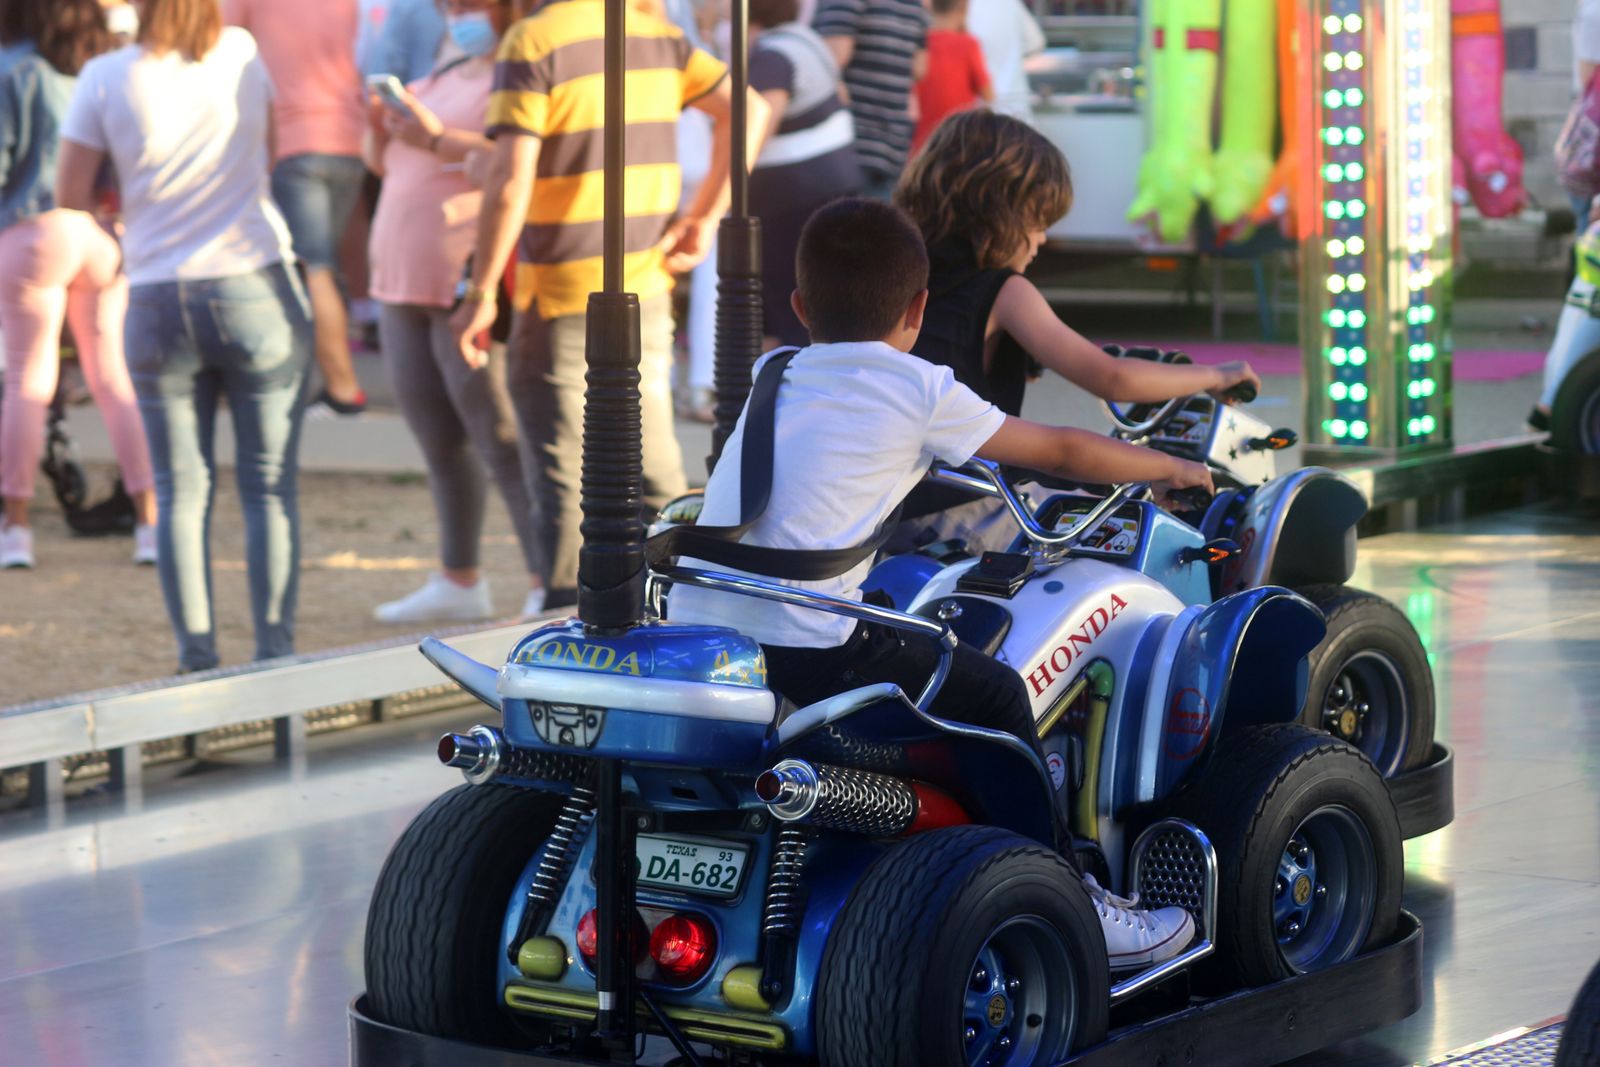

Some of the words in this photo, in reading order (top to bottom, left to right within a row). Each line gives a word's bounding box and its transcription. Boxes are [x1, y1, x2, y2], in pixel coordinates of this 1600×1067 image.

[516, 640, 642, 676] HONDA
[1026, 593, 1129, 698] HONDA
[666, 844, 698, 857] TEXAS
[718, 851, 733, 862] 93
[646, 855, 738, 890] DA-682
